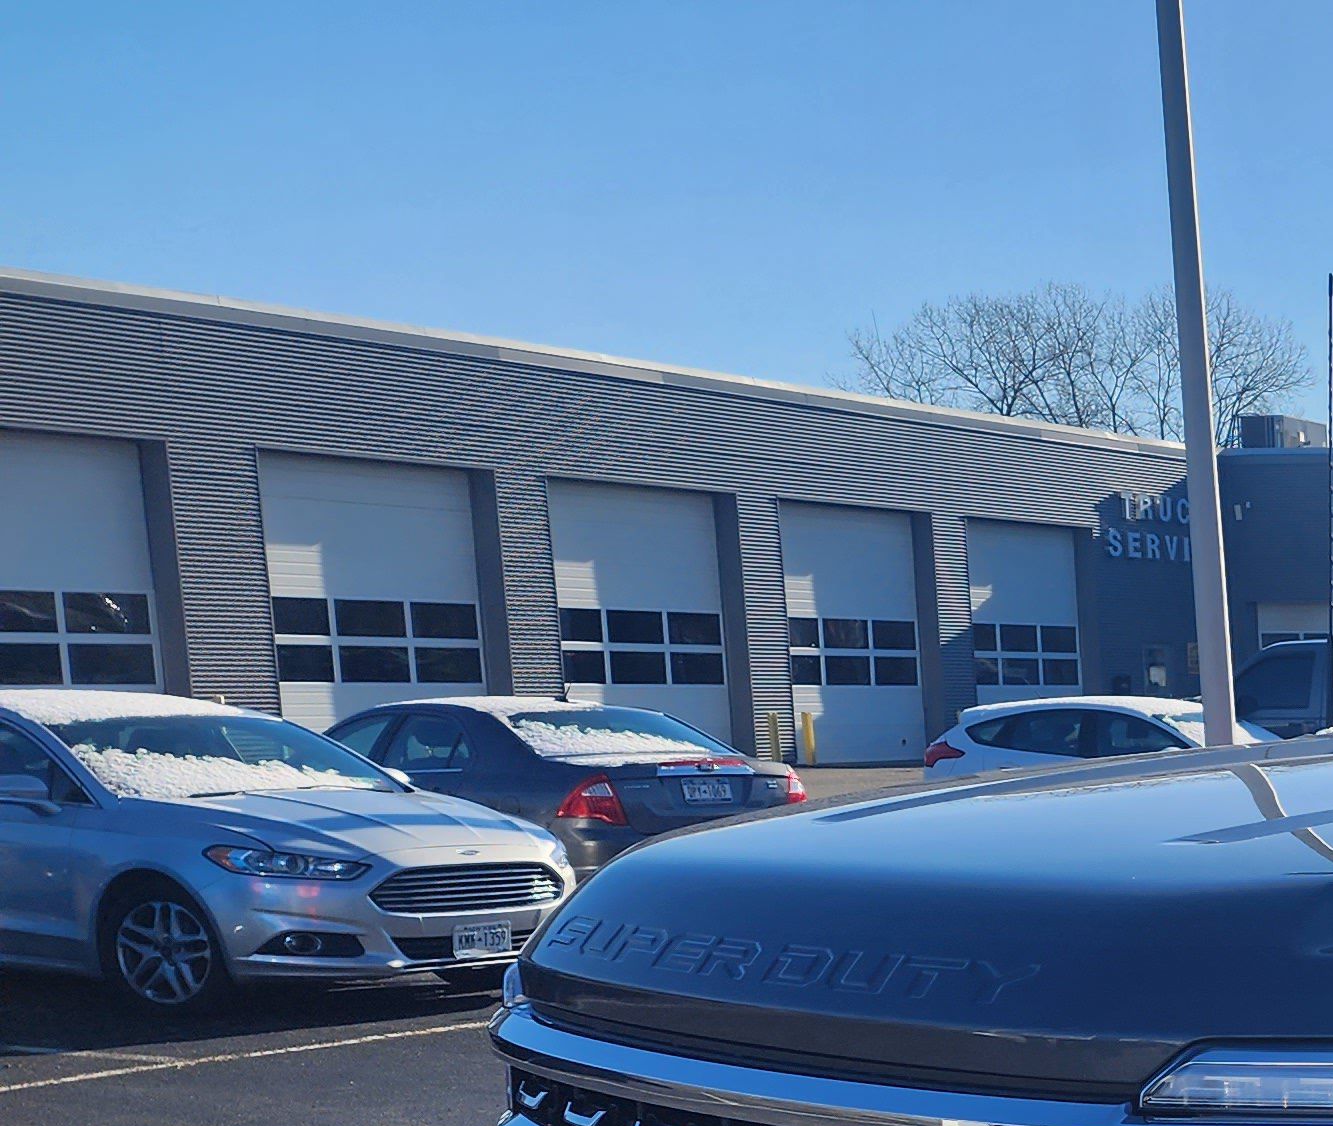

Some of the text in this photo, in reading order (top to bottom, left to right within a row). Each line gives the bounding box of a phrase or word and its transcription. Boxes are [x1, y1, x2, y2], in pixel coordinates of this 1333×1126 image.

[1120, 491, 1191, 523] TRUC
[1107, 529, 1191, 562] SERVI
[548, 915, 1042, 1003] SUPER DUTY
